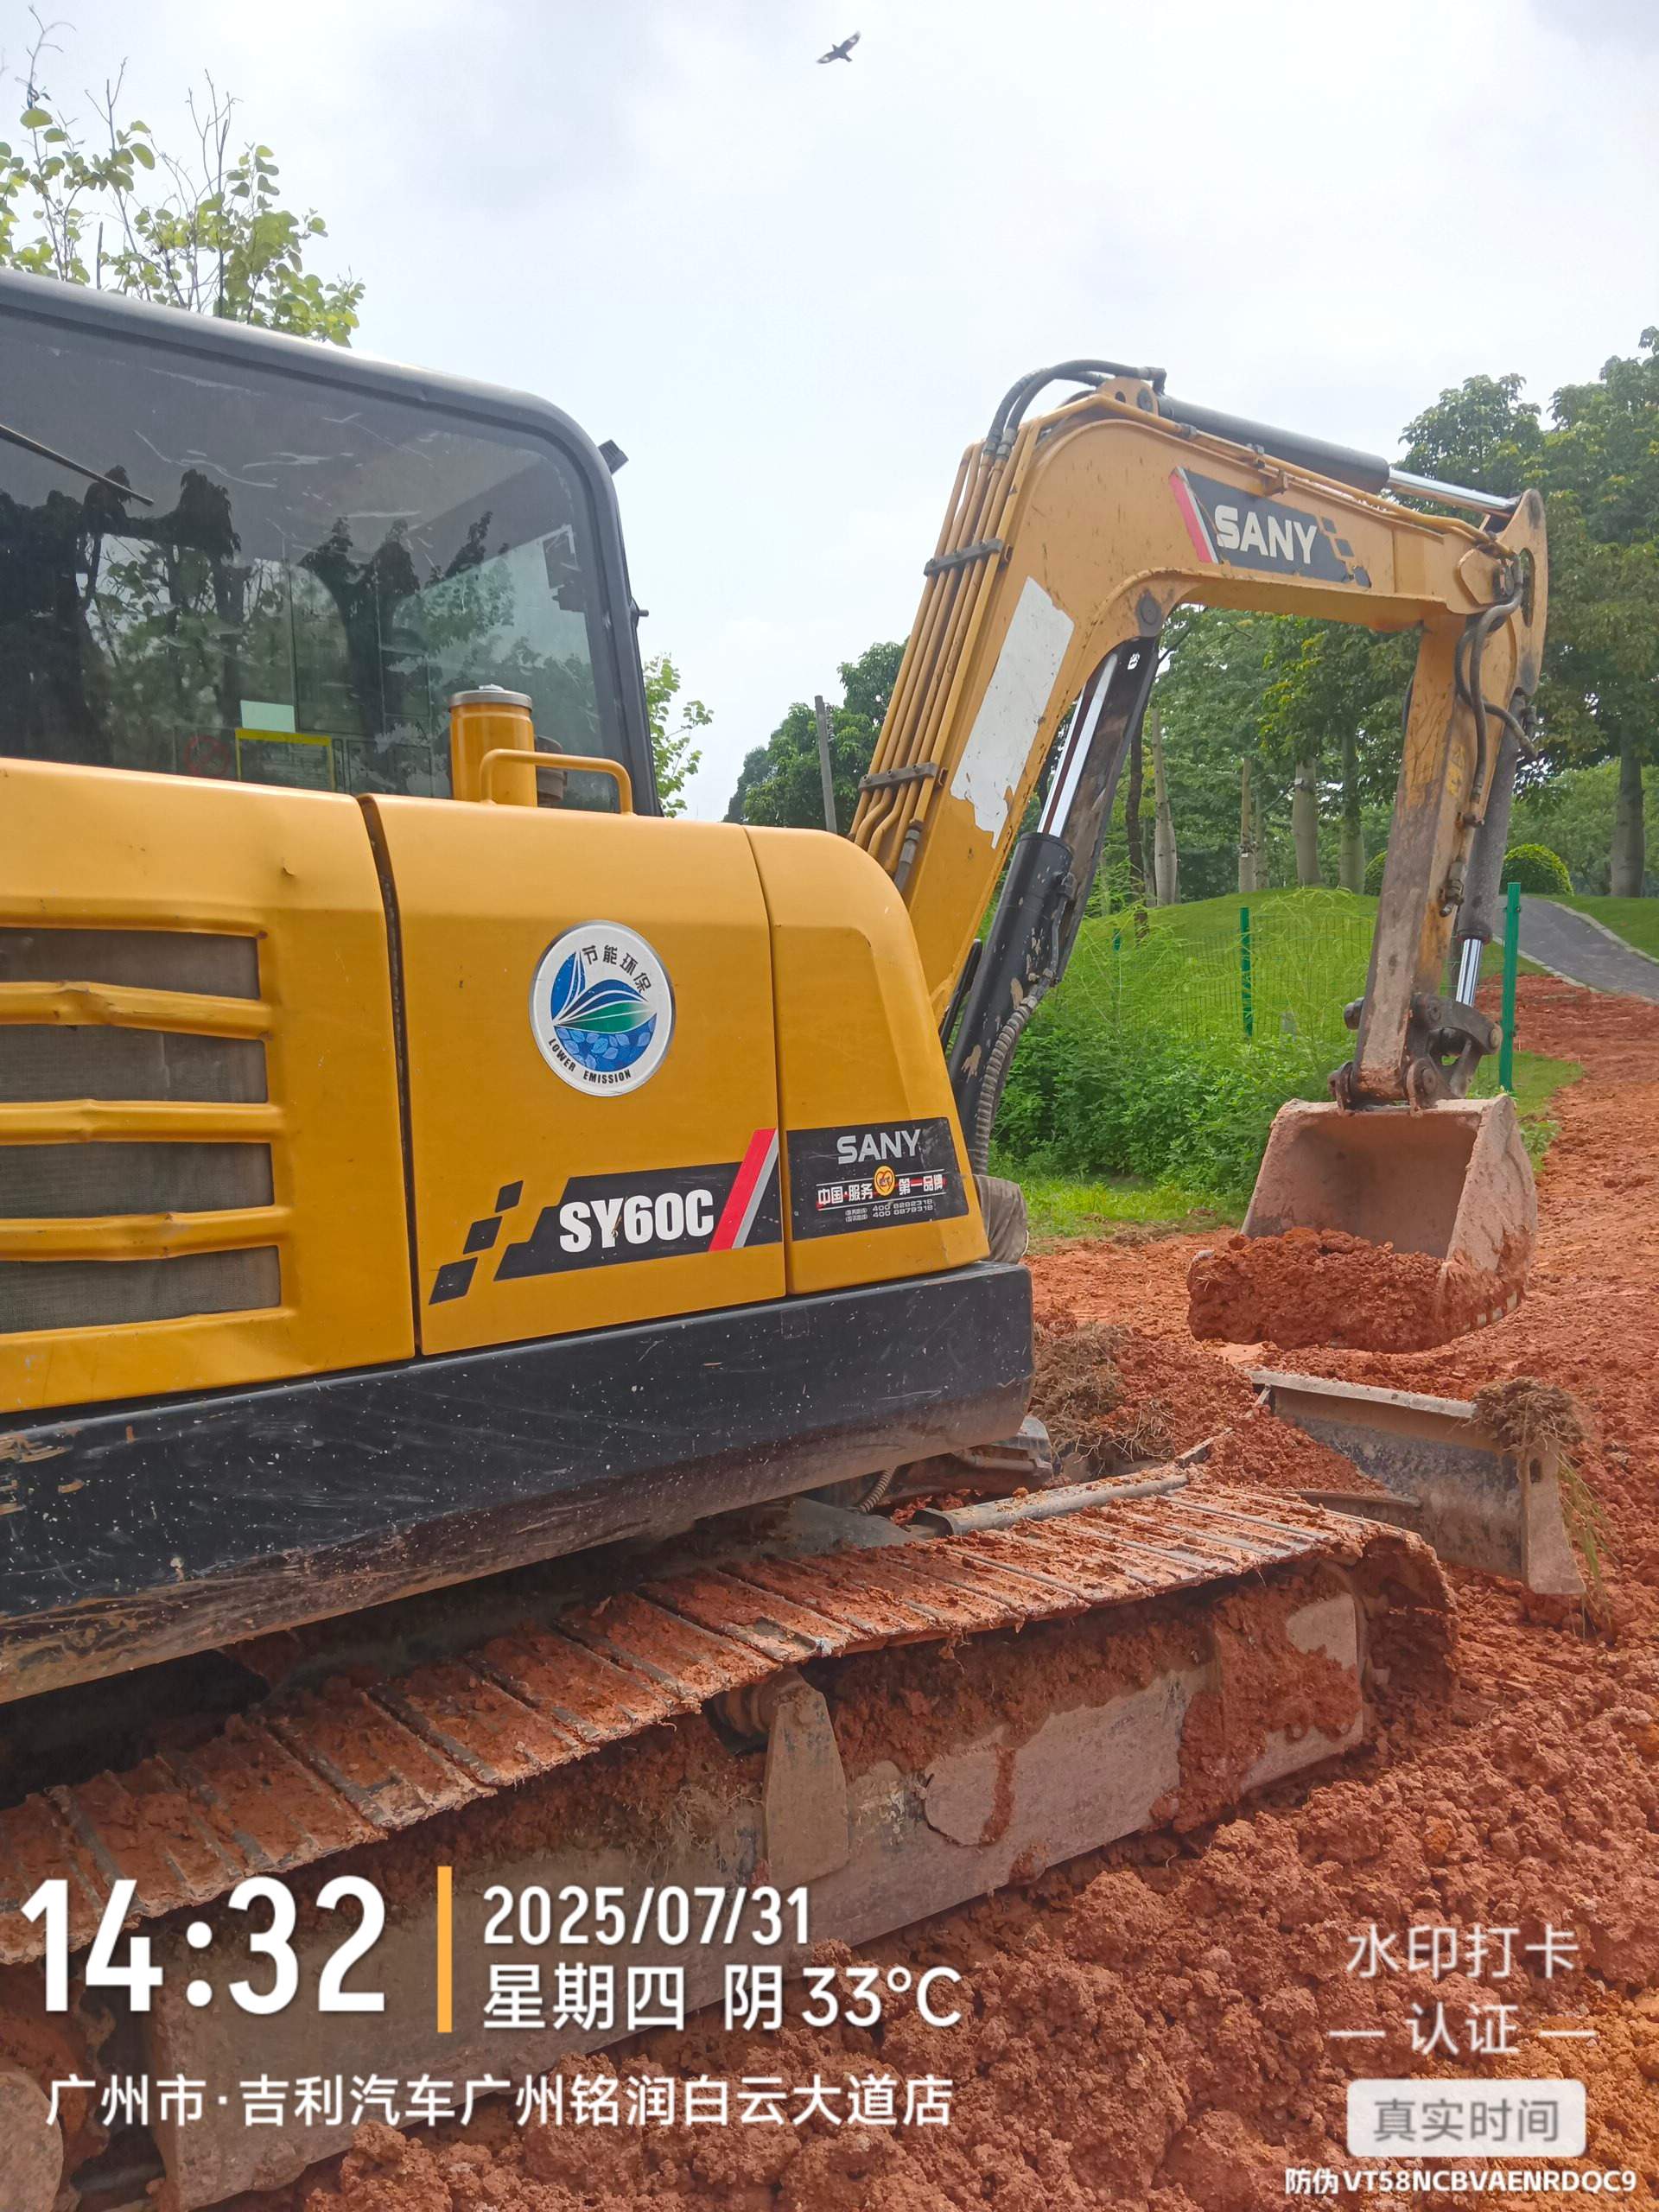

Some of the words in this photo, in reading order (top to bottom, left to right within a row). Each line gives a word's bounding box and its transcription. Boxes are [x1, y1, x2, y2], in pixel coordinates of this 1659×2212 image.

[1214, 504, 1318, 564] SANY
[582, 944, 652, 993] 节能环保
[549, 1038, 576, 1072] LOWER
[583, 1069, 632, 1084] EMISSION
[836, 1128, 921, 1165] SANY
[559, 1189, 715, 1253] SY60C
